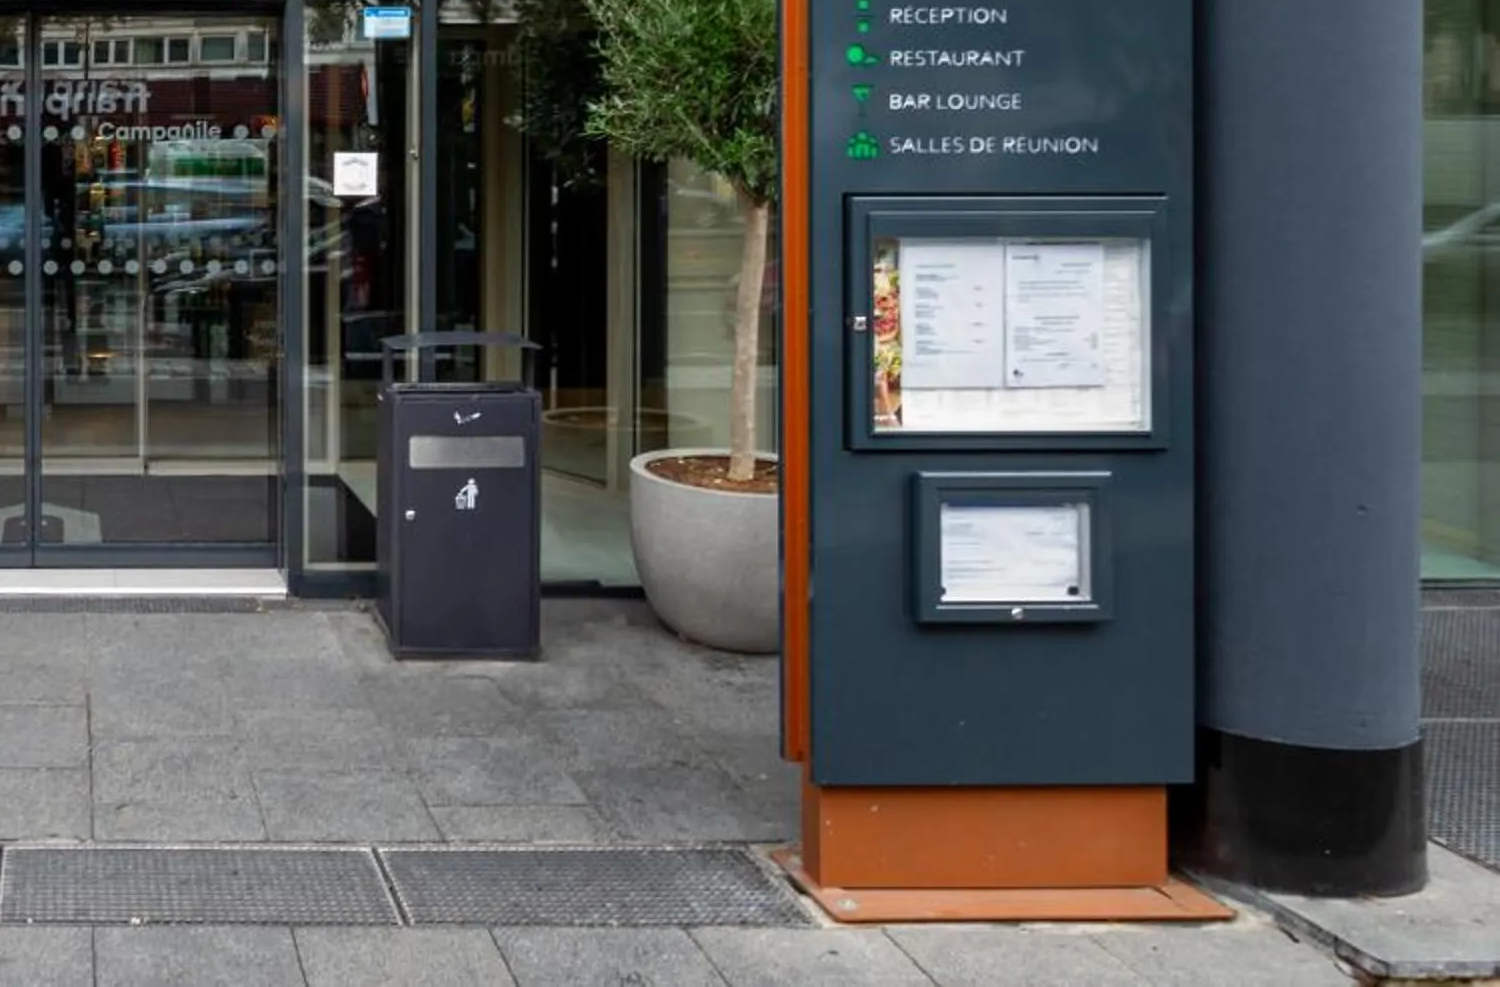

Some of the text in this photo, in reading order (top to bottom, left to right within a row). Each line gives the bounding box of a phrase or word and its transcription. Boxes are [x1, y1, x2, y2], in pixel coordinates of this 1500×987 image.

[889, 49, 1026, 67] RESTAURANT
[888, 92, 1022, 111] BAR LOUNGE
[98, 121, 222, 145] Campanile
[889, 136, 965, 154] SALLES
[969, 136, 997, 154] DE
